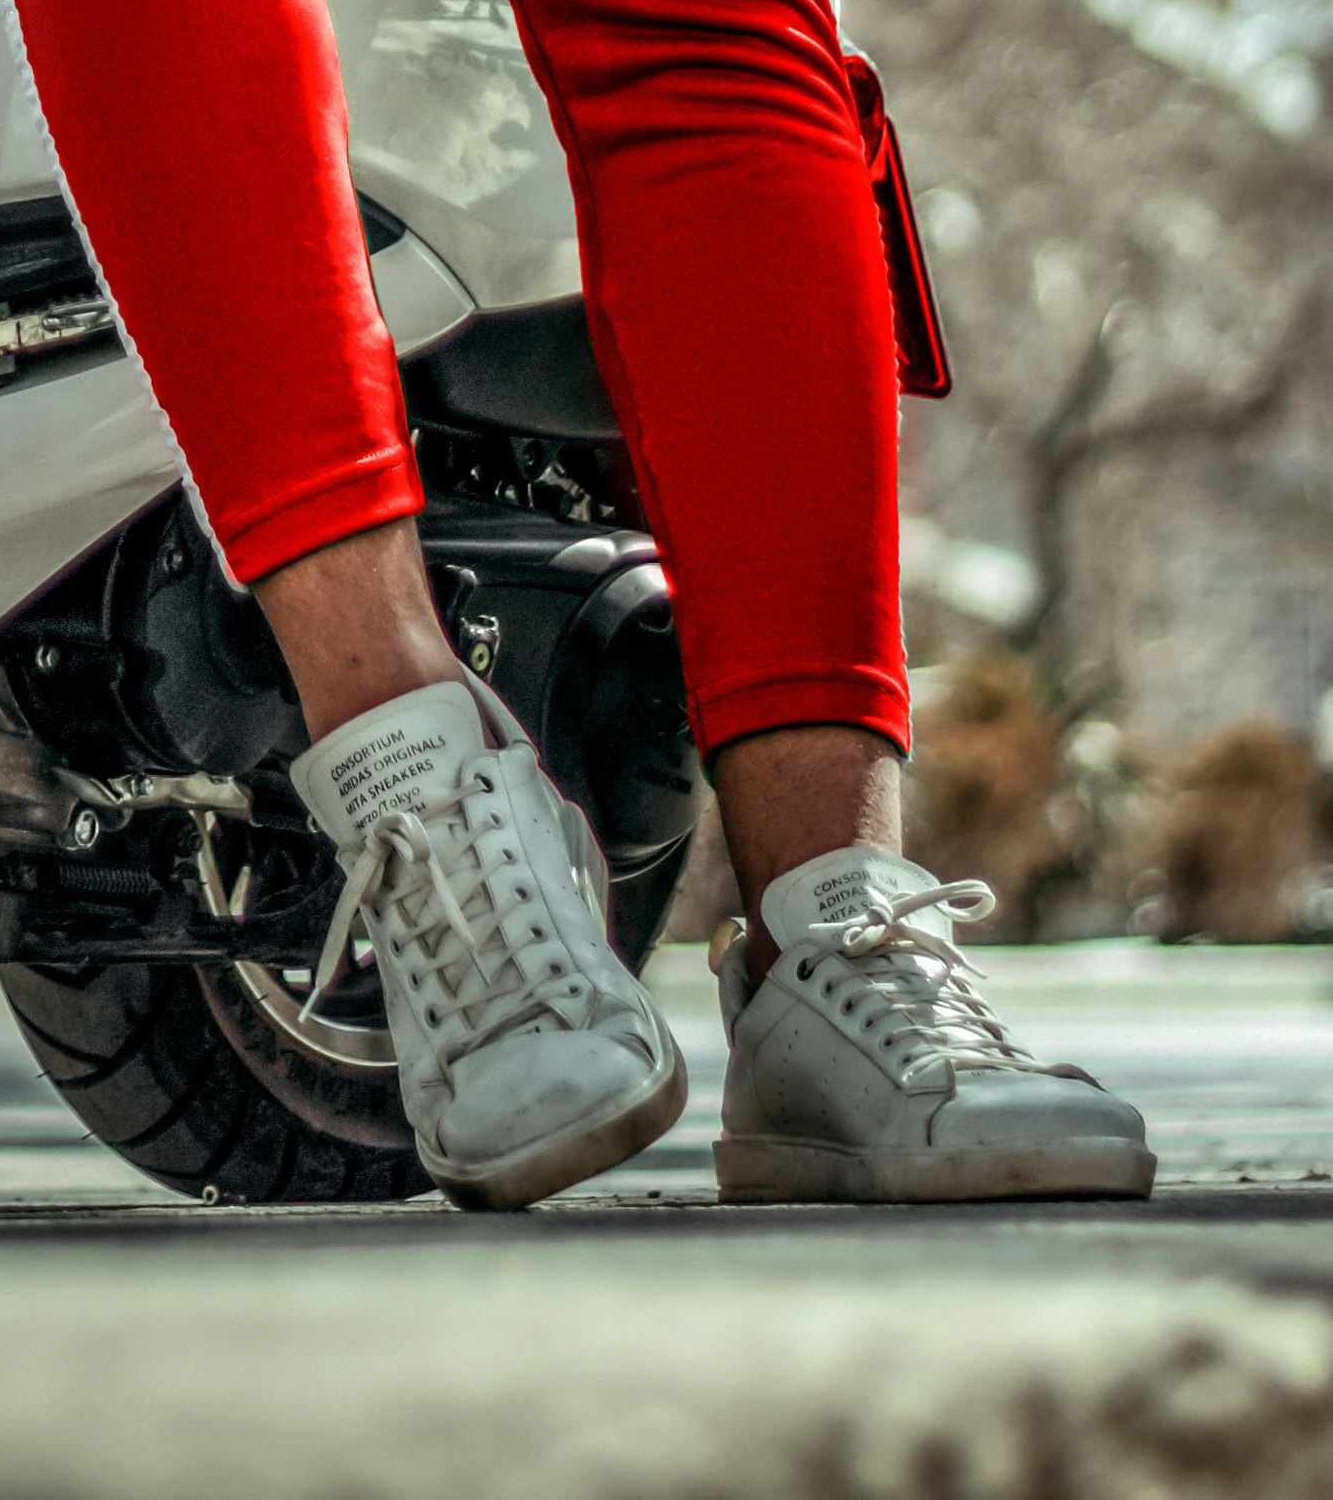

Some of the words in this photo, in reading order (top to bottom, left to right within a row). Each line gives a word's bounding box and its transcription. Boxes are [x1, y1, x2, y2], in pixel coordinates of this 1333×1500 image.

[331, 729, 405, 782] CONSORTIUM
[339, 767, 372, 798] ADIDAS
[374, 734, 446, 772] ORIGINALS
[368, 758, 434, 799] SNEAKERS
